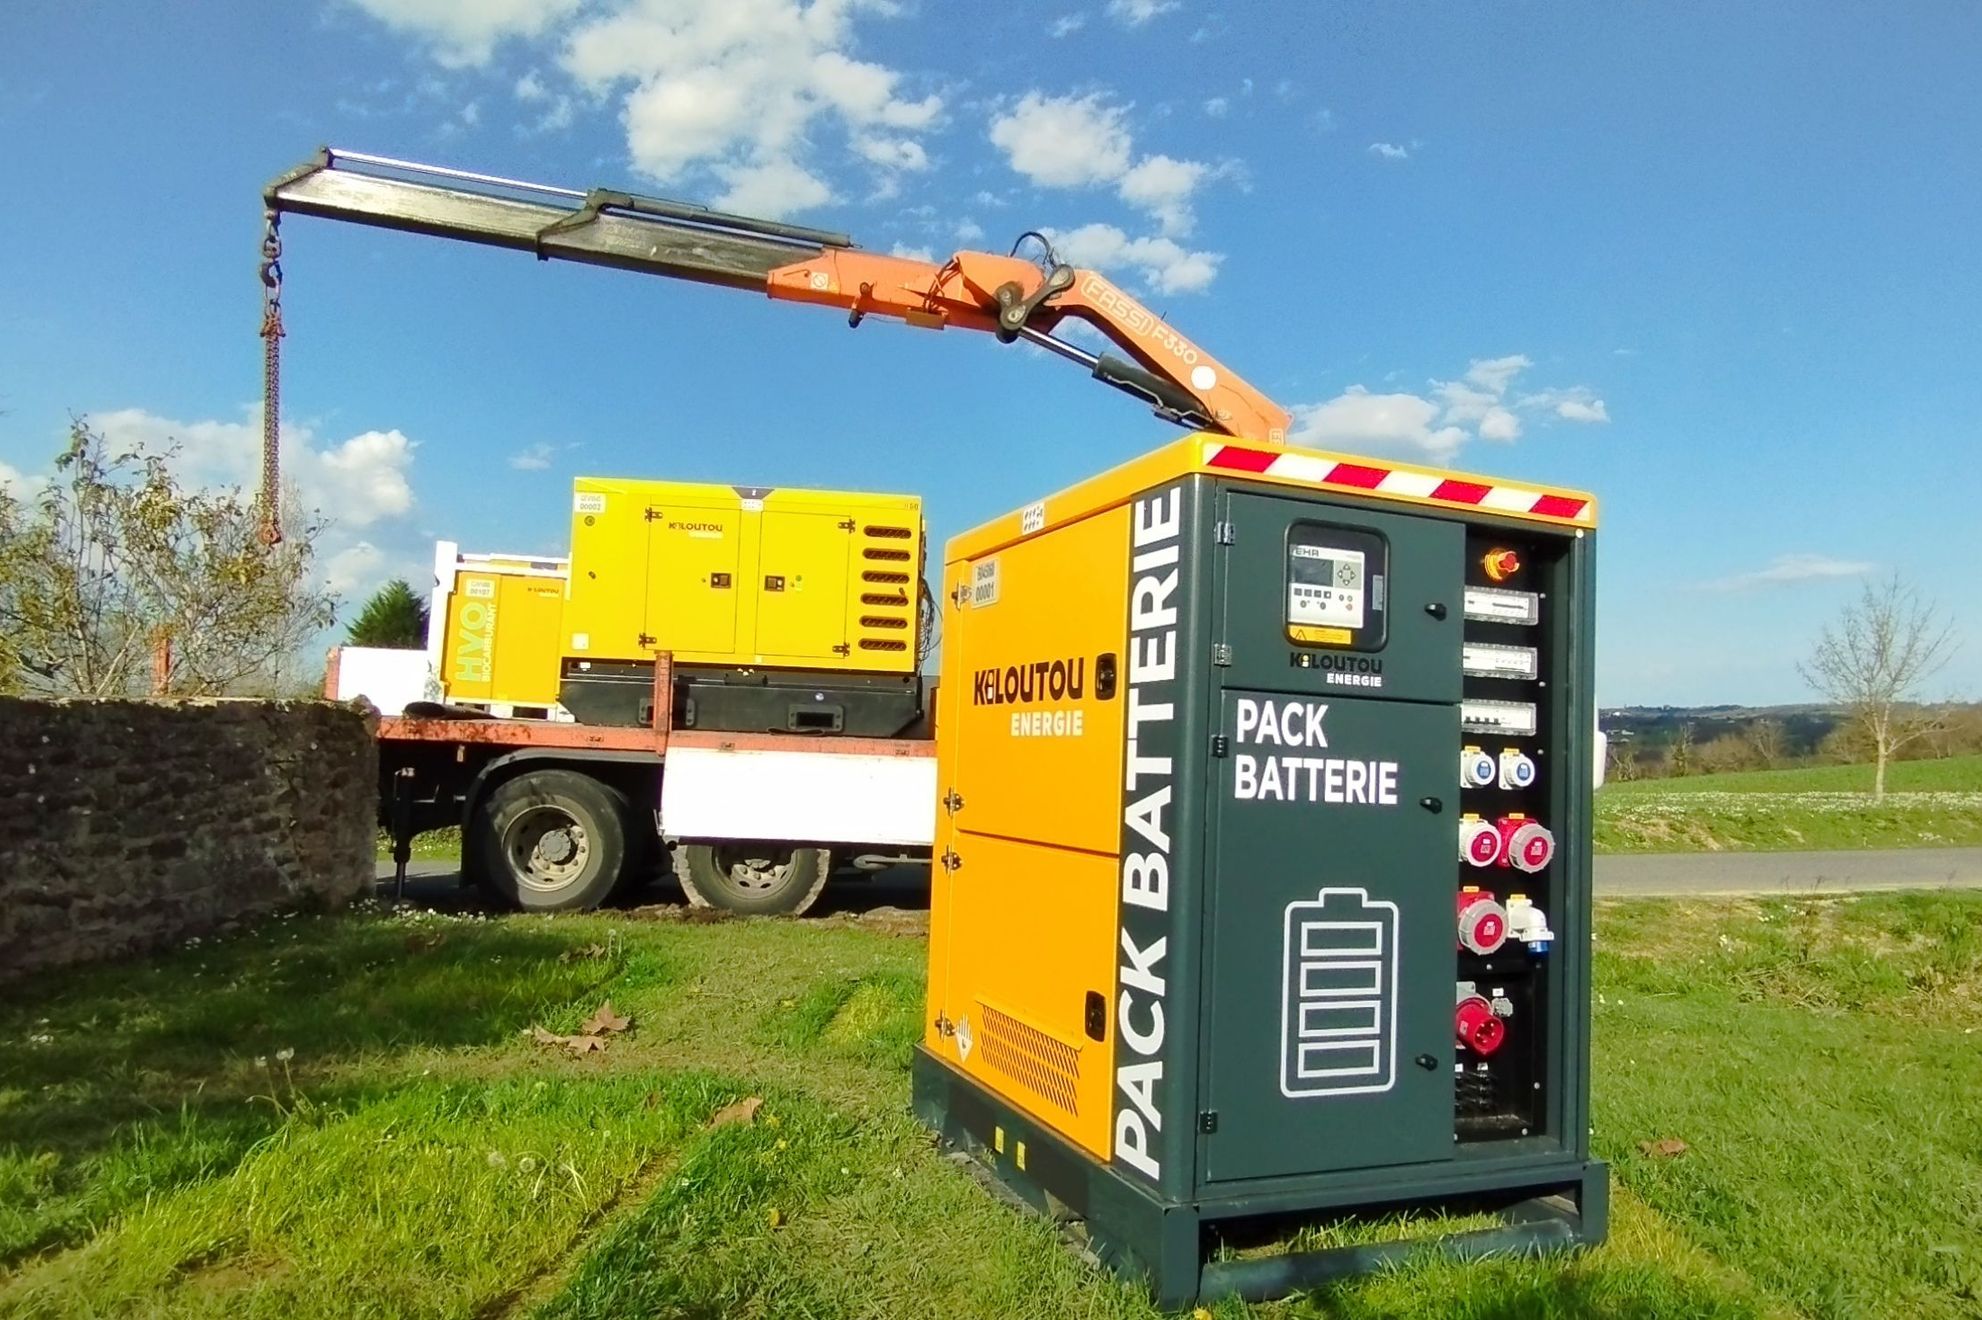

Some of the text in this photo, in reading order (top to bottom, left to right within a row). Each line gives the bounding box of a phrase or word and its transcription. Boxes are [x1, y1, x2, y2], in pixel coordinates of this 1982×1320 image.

[1087, 280, 1198, 365] FASSI F330
[455, 601, 487, 682] HVO
[481, 603, 497, 683] BIOCARBURANT
[1289, 652, 1383, 674] KILOUTOU
[973, 657, 1084, 705] KILOUTOU
[1326, 672, 1383, 687] ENERGIE
[1010, 710, 1083, 736] ENERGIE
[1236, 698, 1329, 748] PACK
[1234, 754, 1398, 805] BATTERIE
[1115, 487, 1181, 1181] PACK BATTERIE
